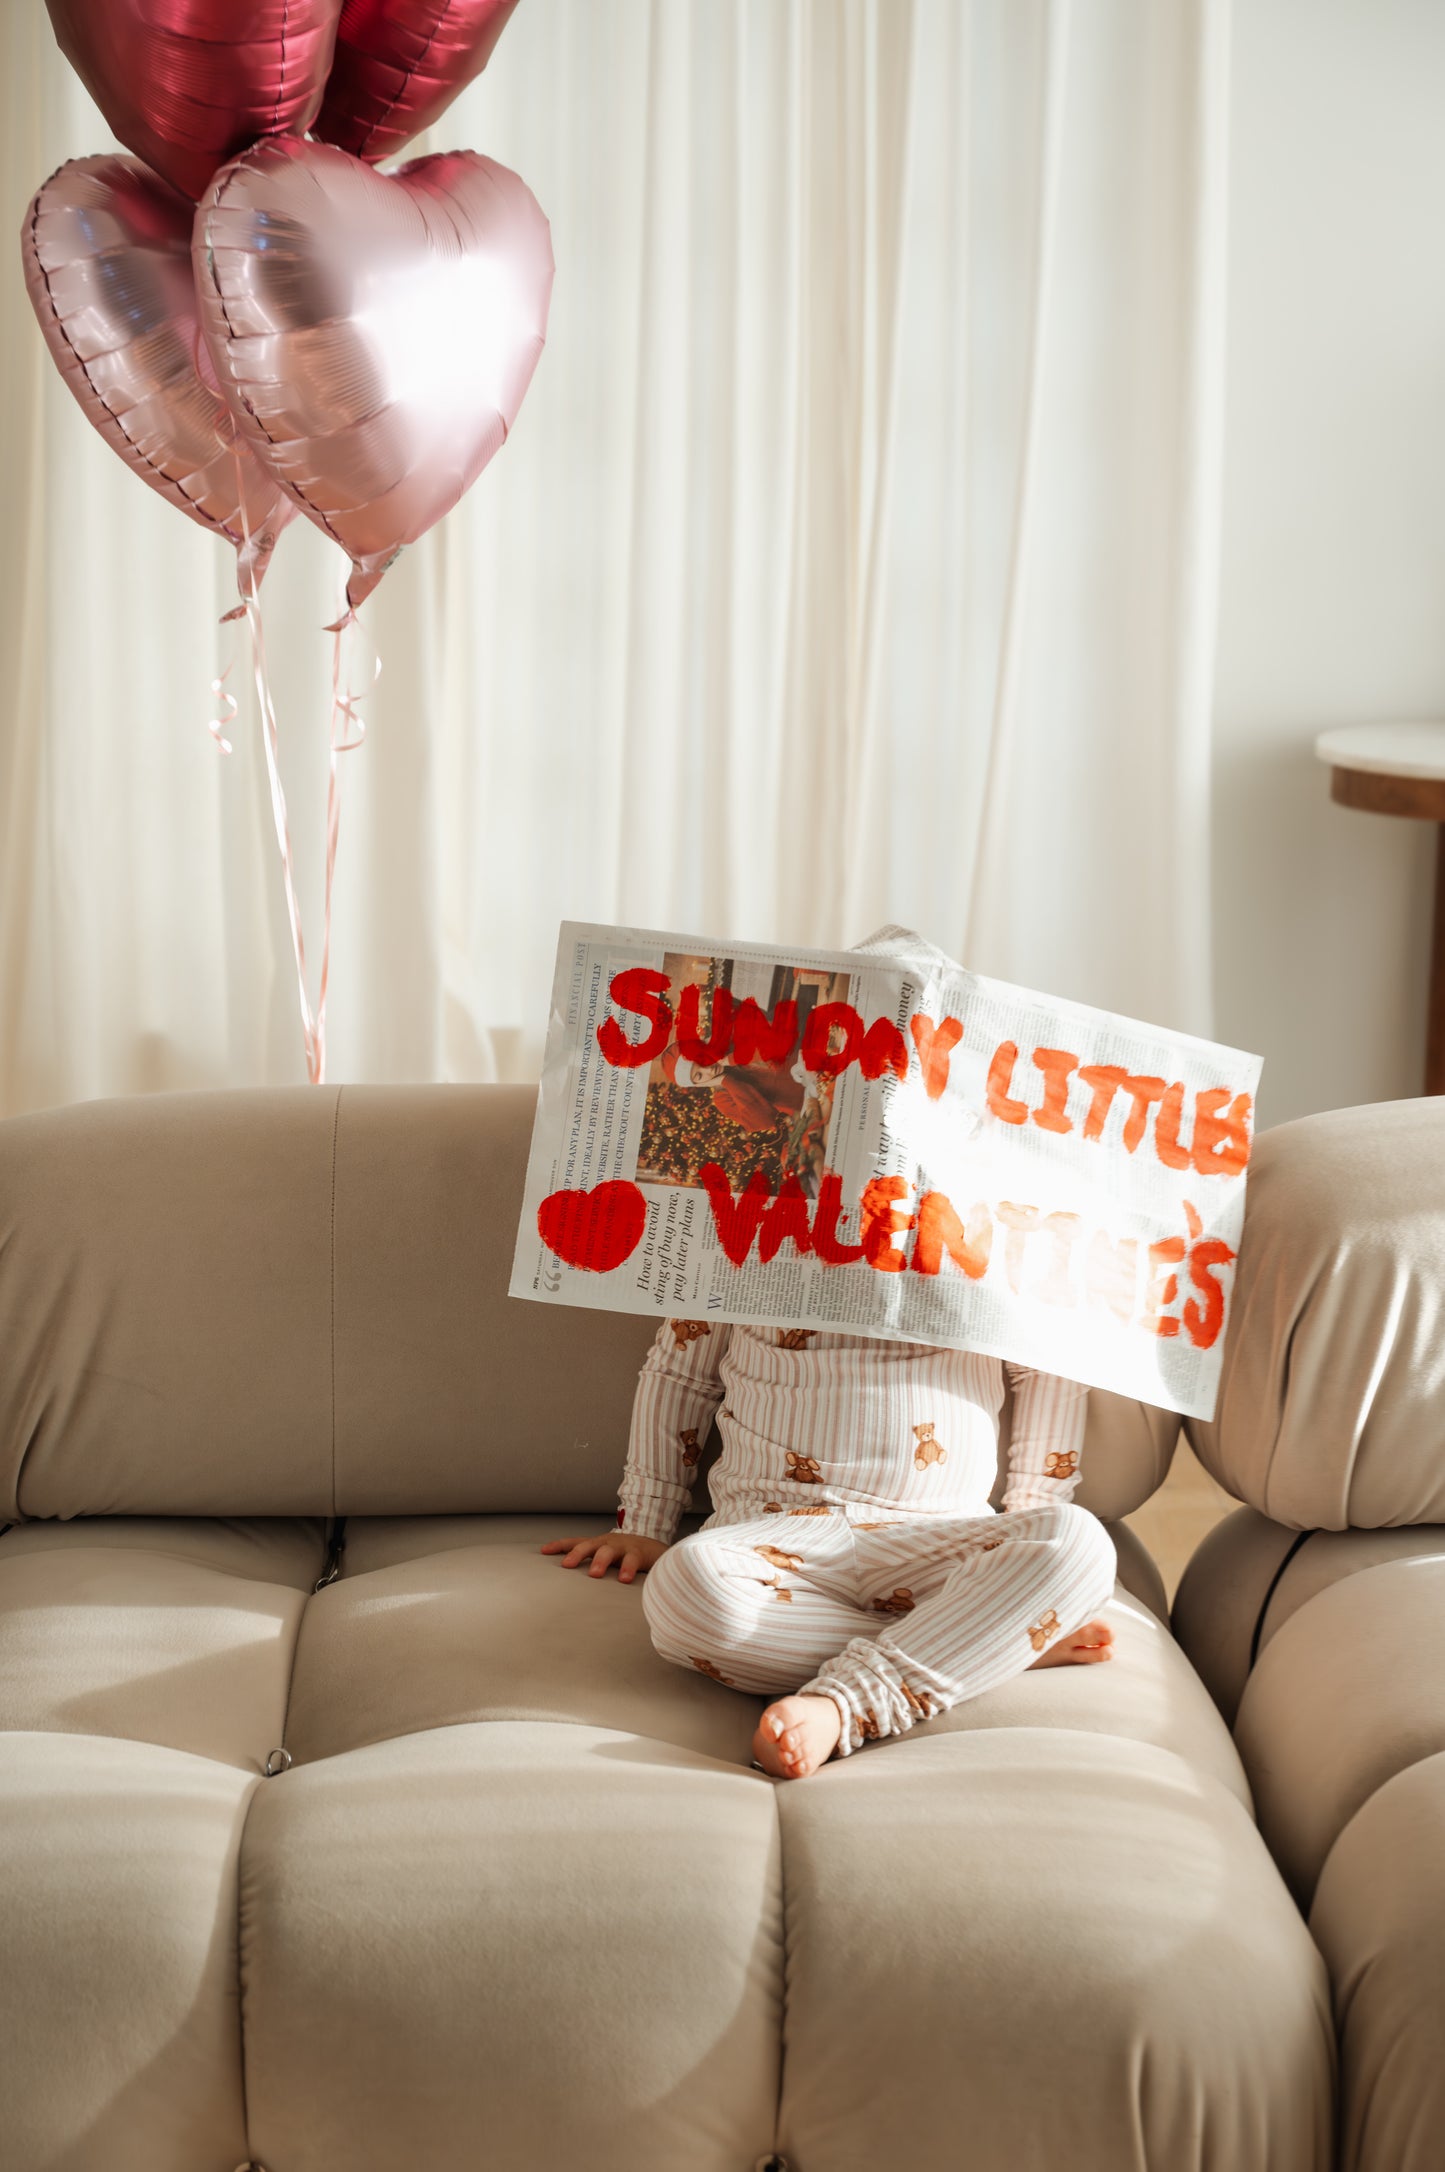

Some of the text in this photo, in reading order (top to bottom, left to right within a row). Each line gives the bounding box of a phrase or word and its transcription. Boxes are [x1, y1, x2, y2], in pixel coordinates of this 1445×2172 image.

[569, 942, 586, 1025] FINANCIAL POST
[587, 963, 602, 1017] CAREFULLY
[585, 1018, 594, 1032] TO
[578, 1031, 592, 1086] IMPORTANT
[877, 1132, 894, 1167] way
[896, 981, 915, 1033] money
[574, 1099, 583, 1108] IT
[576, 1088, 584, 1096] IS
[589, 1059, 604, 1113] REVIEWING
[608, 1070, 619, 1098] THAN
[571, 1109, 583, 1136] PLAN,
[588, 1115, 596, 1127] BY
[602, 1098, 615, 1137] RATHER
[858, 1087, 870, 1131] PERSONAL
[986, 1040, 1252, 1177] LITTLE
[567, 1138, 577, 1158] ANY
[582, 1128, 594, 1167] IDEALLY
[615, 1109, 629, 1160] CHECKOUT
[565, 1158, 574, 1177] FOR
[596, 1139, 610, 1182] WEBSITE,
[613, 1160, 622, 1179] THE
[563, 1178, 572, 1191] UP
[636, 1200, 661, 1291] How to avoid
[652, 1191, 681, 1306] sting of buy now,
[672, 1197, 699, 1302] pay later plans
